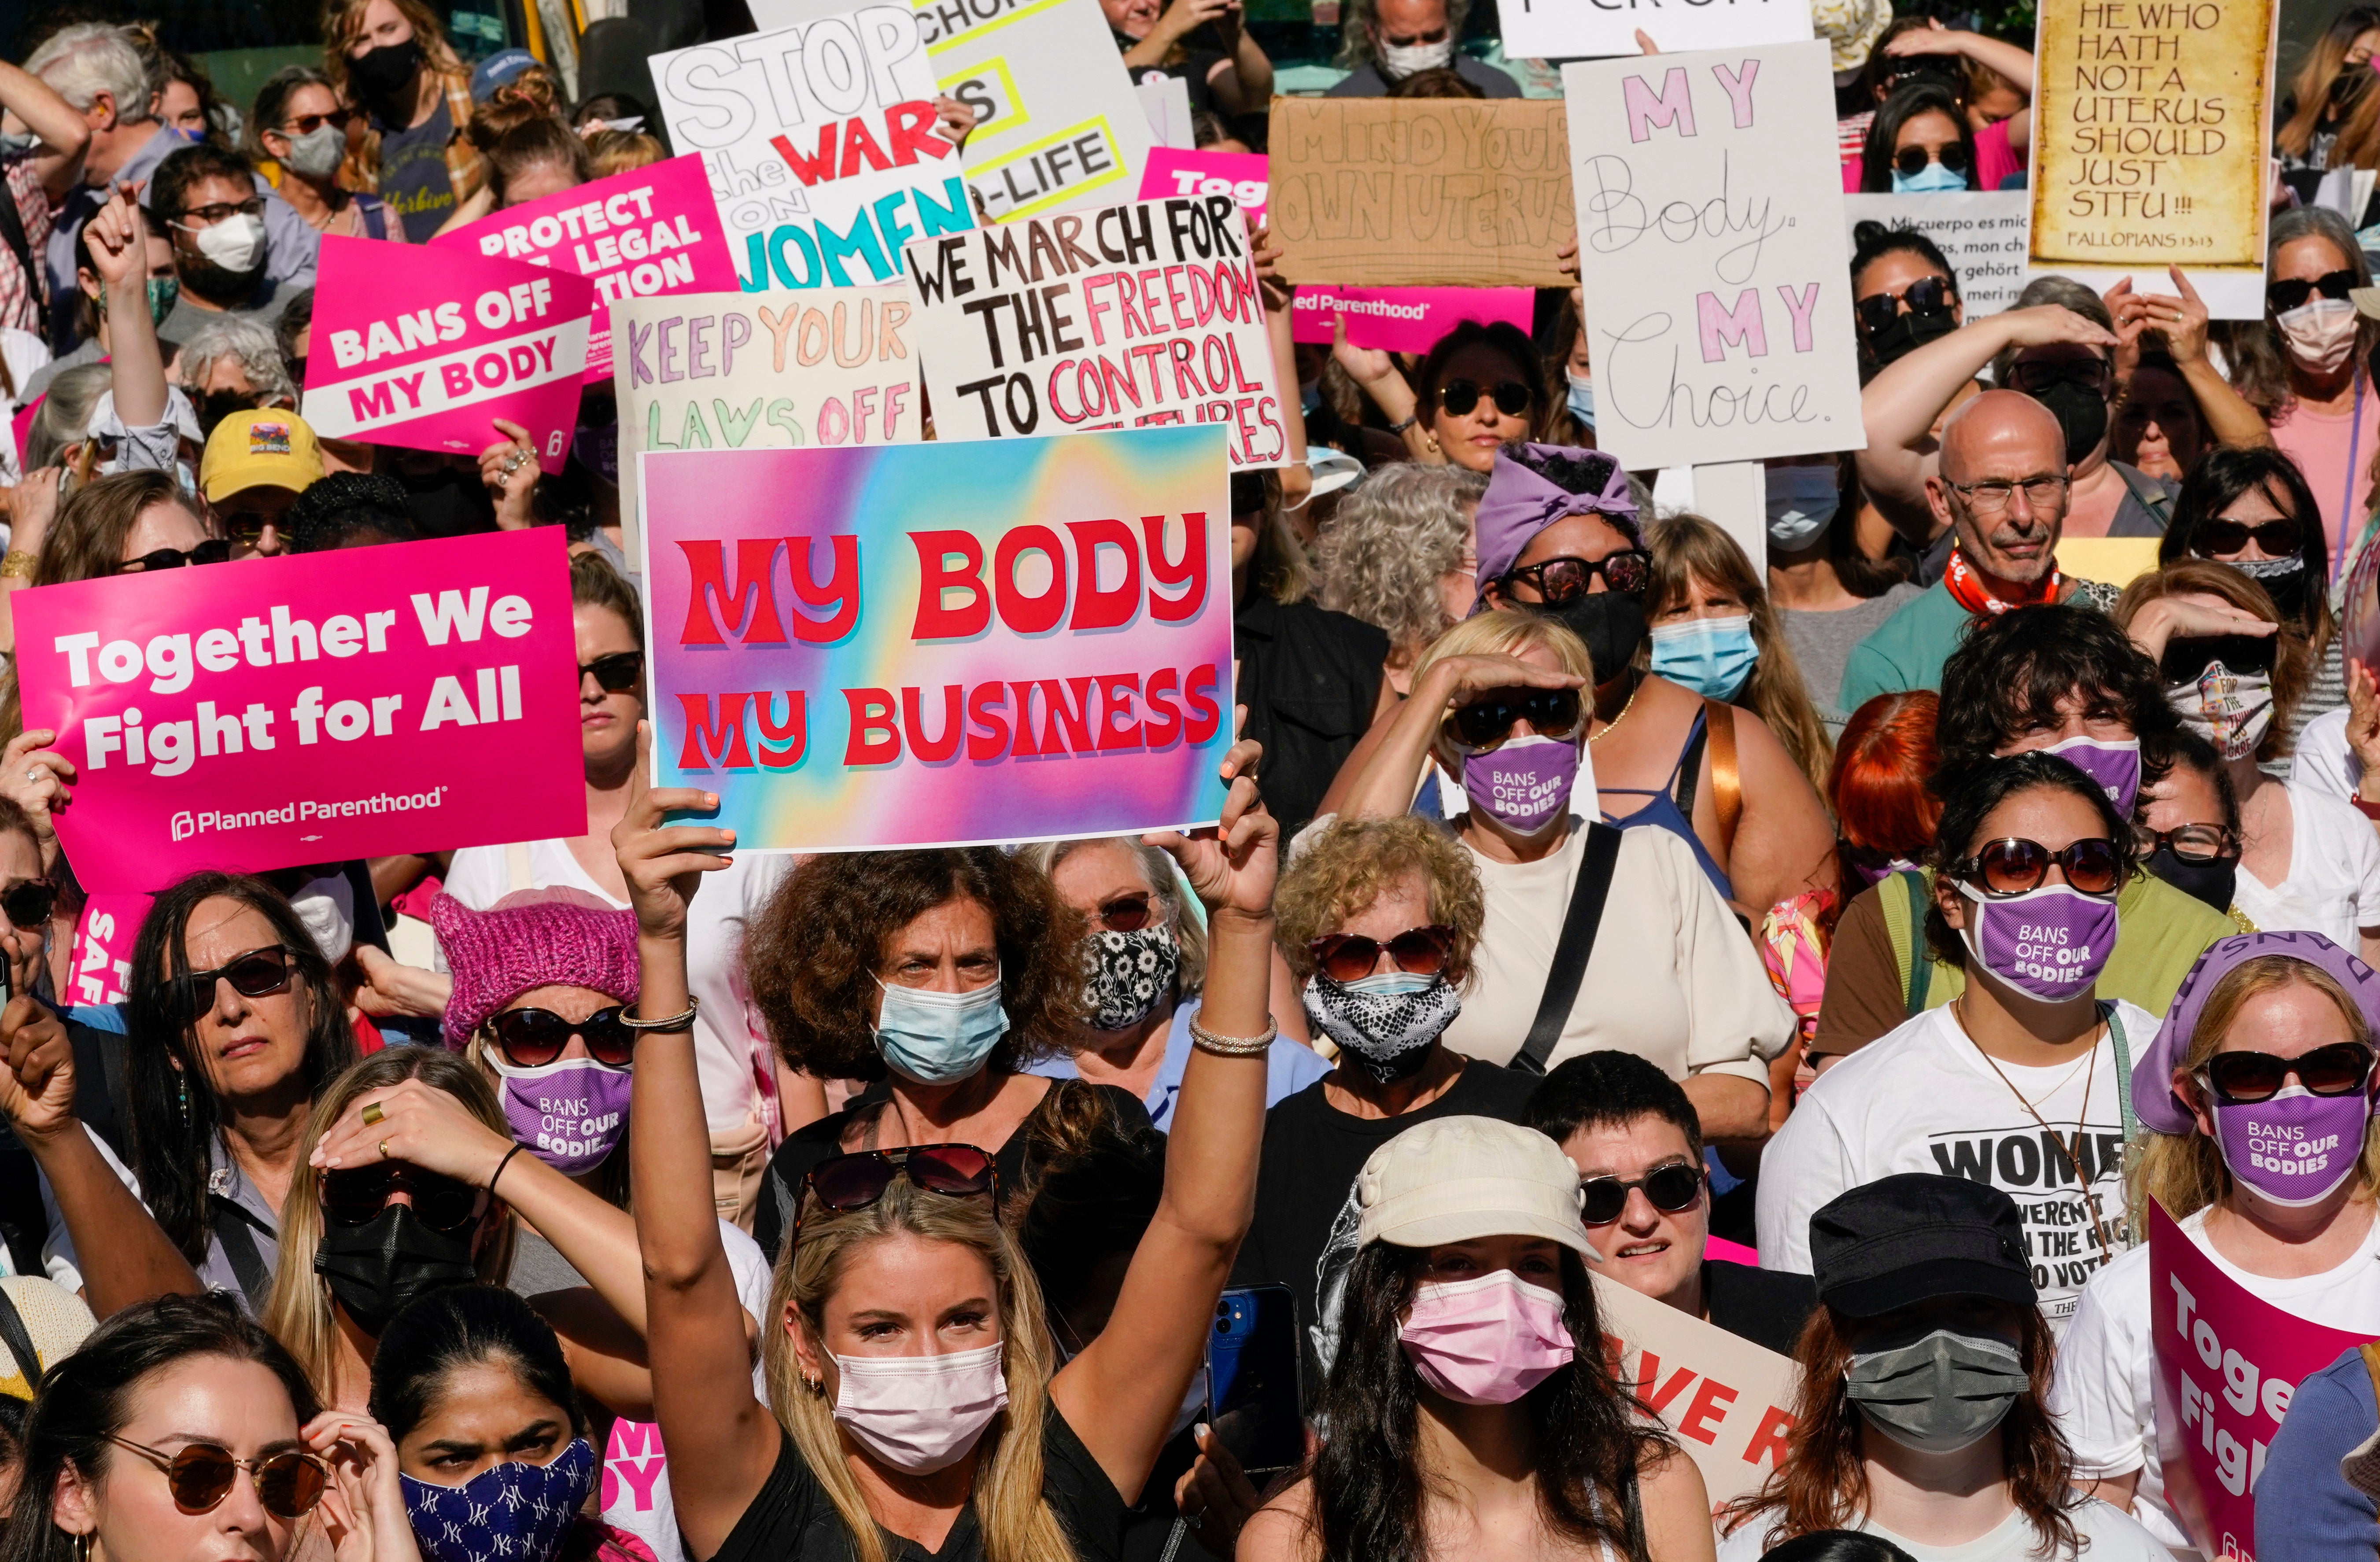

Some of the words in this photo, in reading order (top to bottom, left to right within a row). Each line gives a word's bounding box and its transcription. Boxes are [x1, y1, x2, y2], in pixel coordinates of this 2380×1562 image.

[2078, 4, 2130, 29] HE
[2137, 4, 2220, 29] WHO
[2077, 34, 2179, 60] HATH
[665, 6, 919, 148] STOP
[2075, 65, 2154, 91] NOT
[2159, 67, 2186, 92] A
[1622, 59, 1760, 144] MY
[2073, 96, 2226, 124] UTERUS
[770, 99, 954, 187] WAR
[1284, 103, 1446, 166] MIND
[2071, 127, 2226, 156] SHOULD
[2069, 159, 2167, 187] JUST
[730, 188, 811, 231] ON
[1276, 170, 1394, 241] OWN
[2068, 191, 2167, 218] STFU
[480, 185, 654, 258] PROTECT
[1917, 219, 1973, 234] cuerpo
[1978, 220, 1995, 228] es
[574, 214, 701, 275] LEGAL
[1964, 243, 1999, 253] mon
[2067, 231, 2177, 247] FALLOPIANS
[907, 236, 975, 307] WE
[983, 205, 1157, 289] MARCH
[1965, 261, 2019, 281] gehört
[329, 302, 467, 369] BANS
[475, 277, 553, 330] OFF
[962, 282, 1085, 369] THE
[1082, 256, 1264, 347] FREEDOM
[1696, 282, 1820, 363] MY
[628, 313, 752, 390] KEEP
[758, 298, 912, 373] YOUR
[347, 370, 426, 423] MY
[439, 335, 557, 399] BODY
[956, 371, 1039, 437] TO
[1048, 332, 1263, 424] CONTROL
[647, 398, 804, 451] LAWS
[817, 381, 910, 445] OFF
[673, 534, 862, 649] MY
[905, 512, 1210, 644] BODY
[54, 605, 395, 694] Together
[410, 586, 532, 646] We
[84, 700, 276, 777] Fight
[291, 685, 402, 745] for
[419, 665, 523, 732] All
[673, 689, 809, 774] MY
[839, 663, 1222, 770] BUSINESS
[1492, 785, 1526, 802] OFF
[1529, 775, 1562, 800] OUR
[1493, 771, 1536, 787] BANS
[198, 803, 295, 833] Planned
[1494, 792, 1556, 817] BODIES
[2018, 925, 2069, 945] BANS
[2015, 943, 2054, 962] OFF
[2056, 945, 2091, 965] OUR
[2015, 959, 2084, 983] BODIES
[539, 1098, 589, 1117] BANS
[542, 1115, 577, 1137] OFF
[580, 1112, 619, 1136] OUR
[2247, 1122, 2305, 1140] BANS
[2248, 1138, 2290, 1157] OFF
[2293, 1134, 2339, 1158] OUR
[2250, 1153, 2328, 1176] BODIES
[2038, 1231, 2082, 1257] THE
